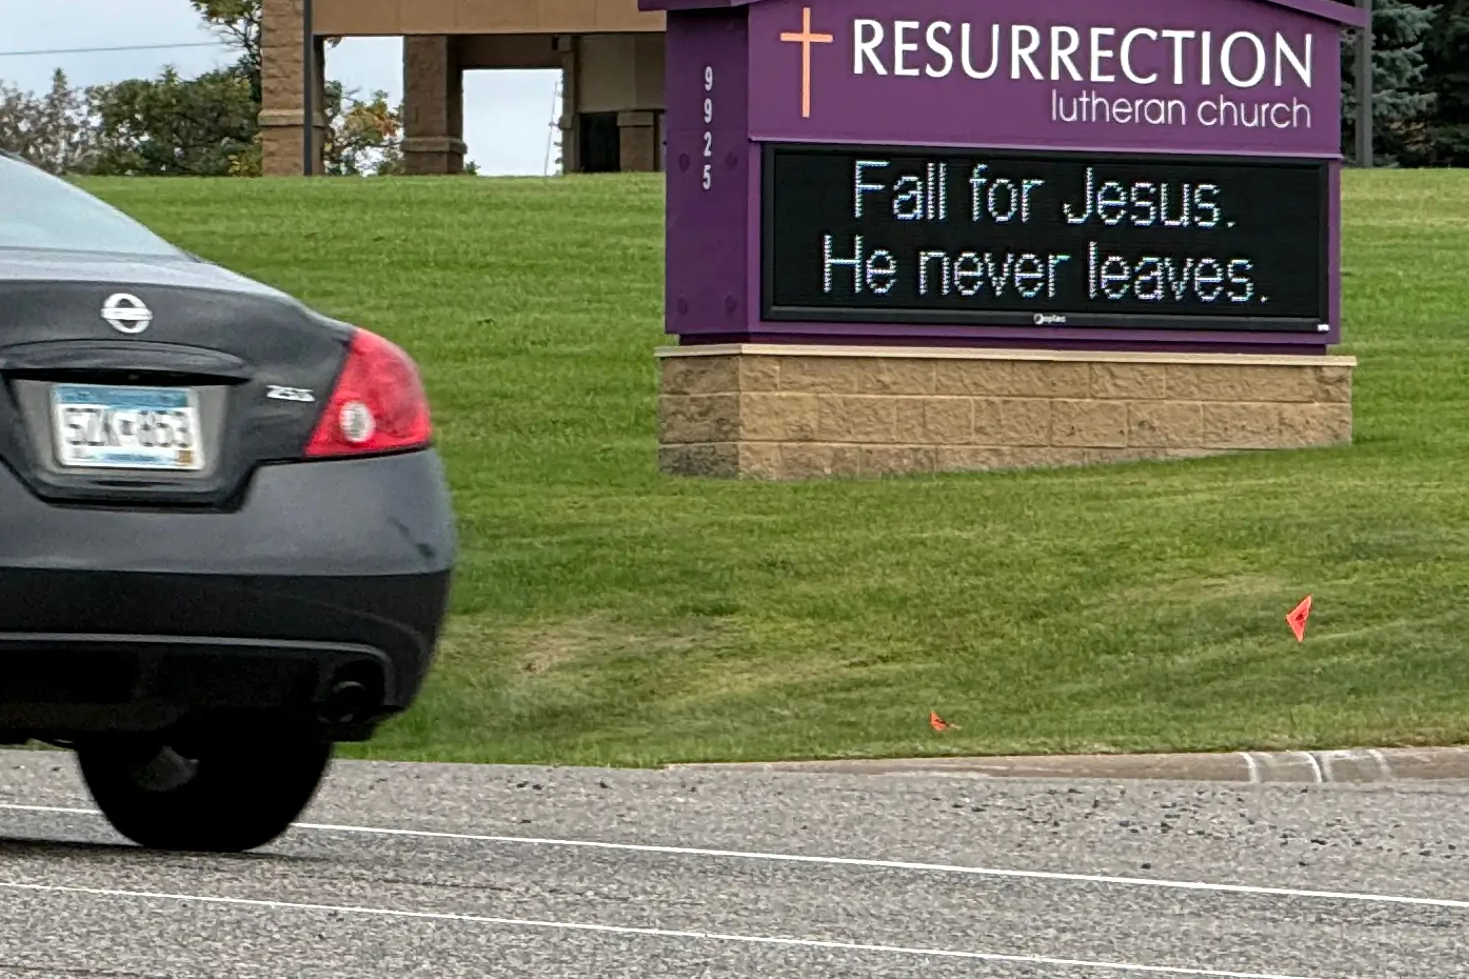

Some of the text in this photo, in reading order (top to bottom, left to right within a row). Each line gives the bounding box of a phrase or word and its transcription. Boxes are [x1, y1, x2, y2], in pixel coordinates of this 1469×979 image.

[852, 19, 1312, 88] RESURRECTION
[702, 65, 713, 190] 9925
[1052, 88, 1311, 129] lutheran church
[854, 159, 1236, 228] Fall for Jesus.
[822, 234, 1269, 304] He never leaves.
